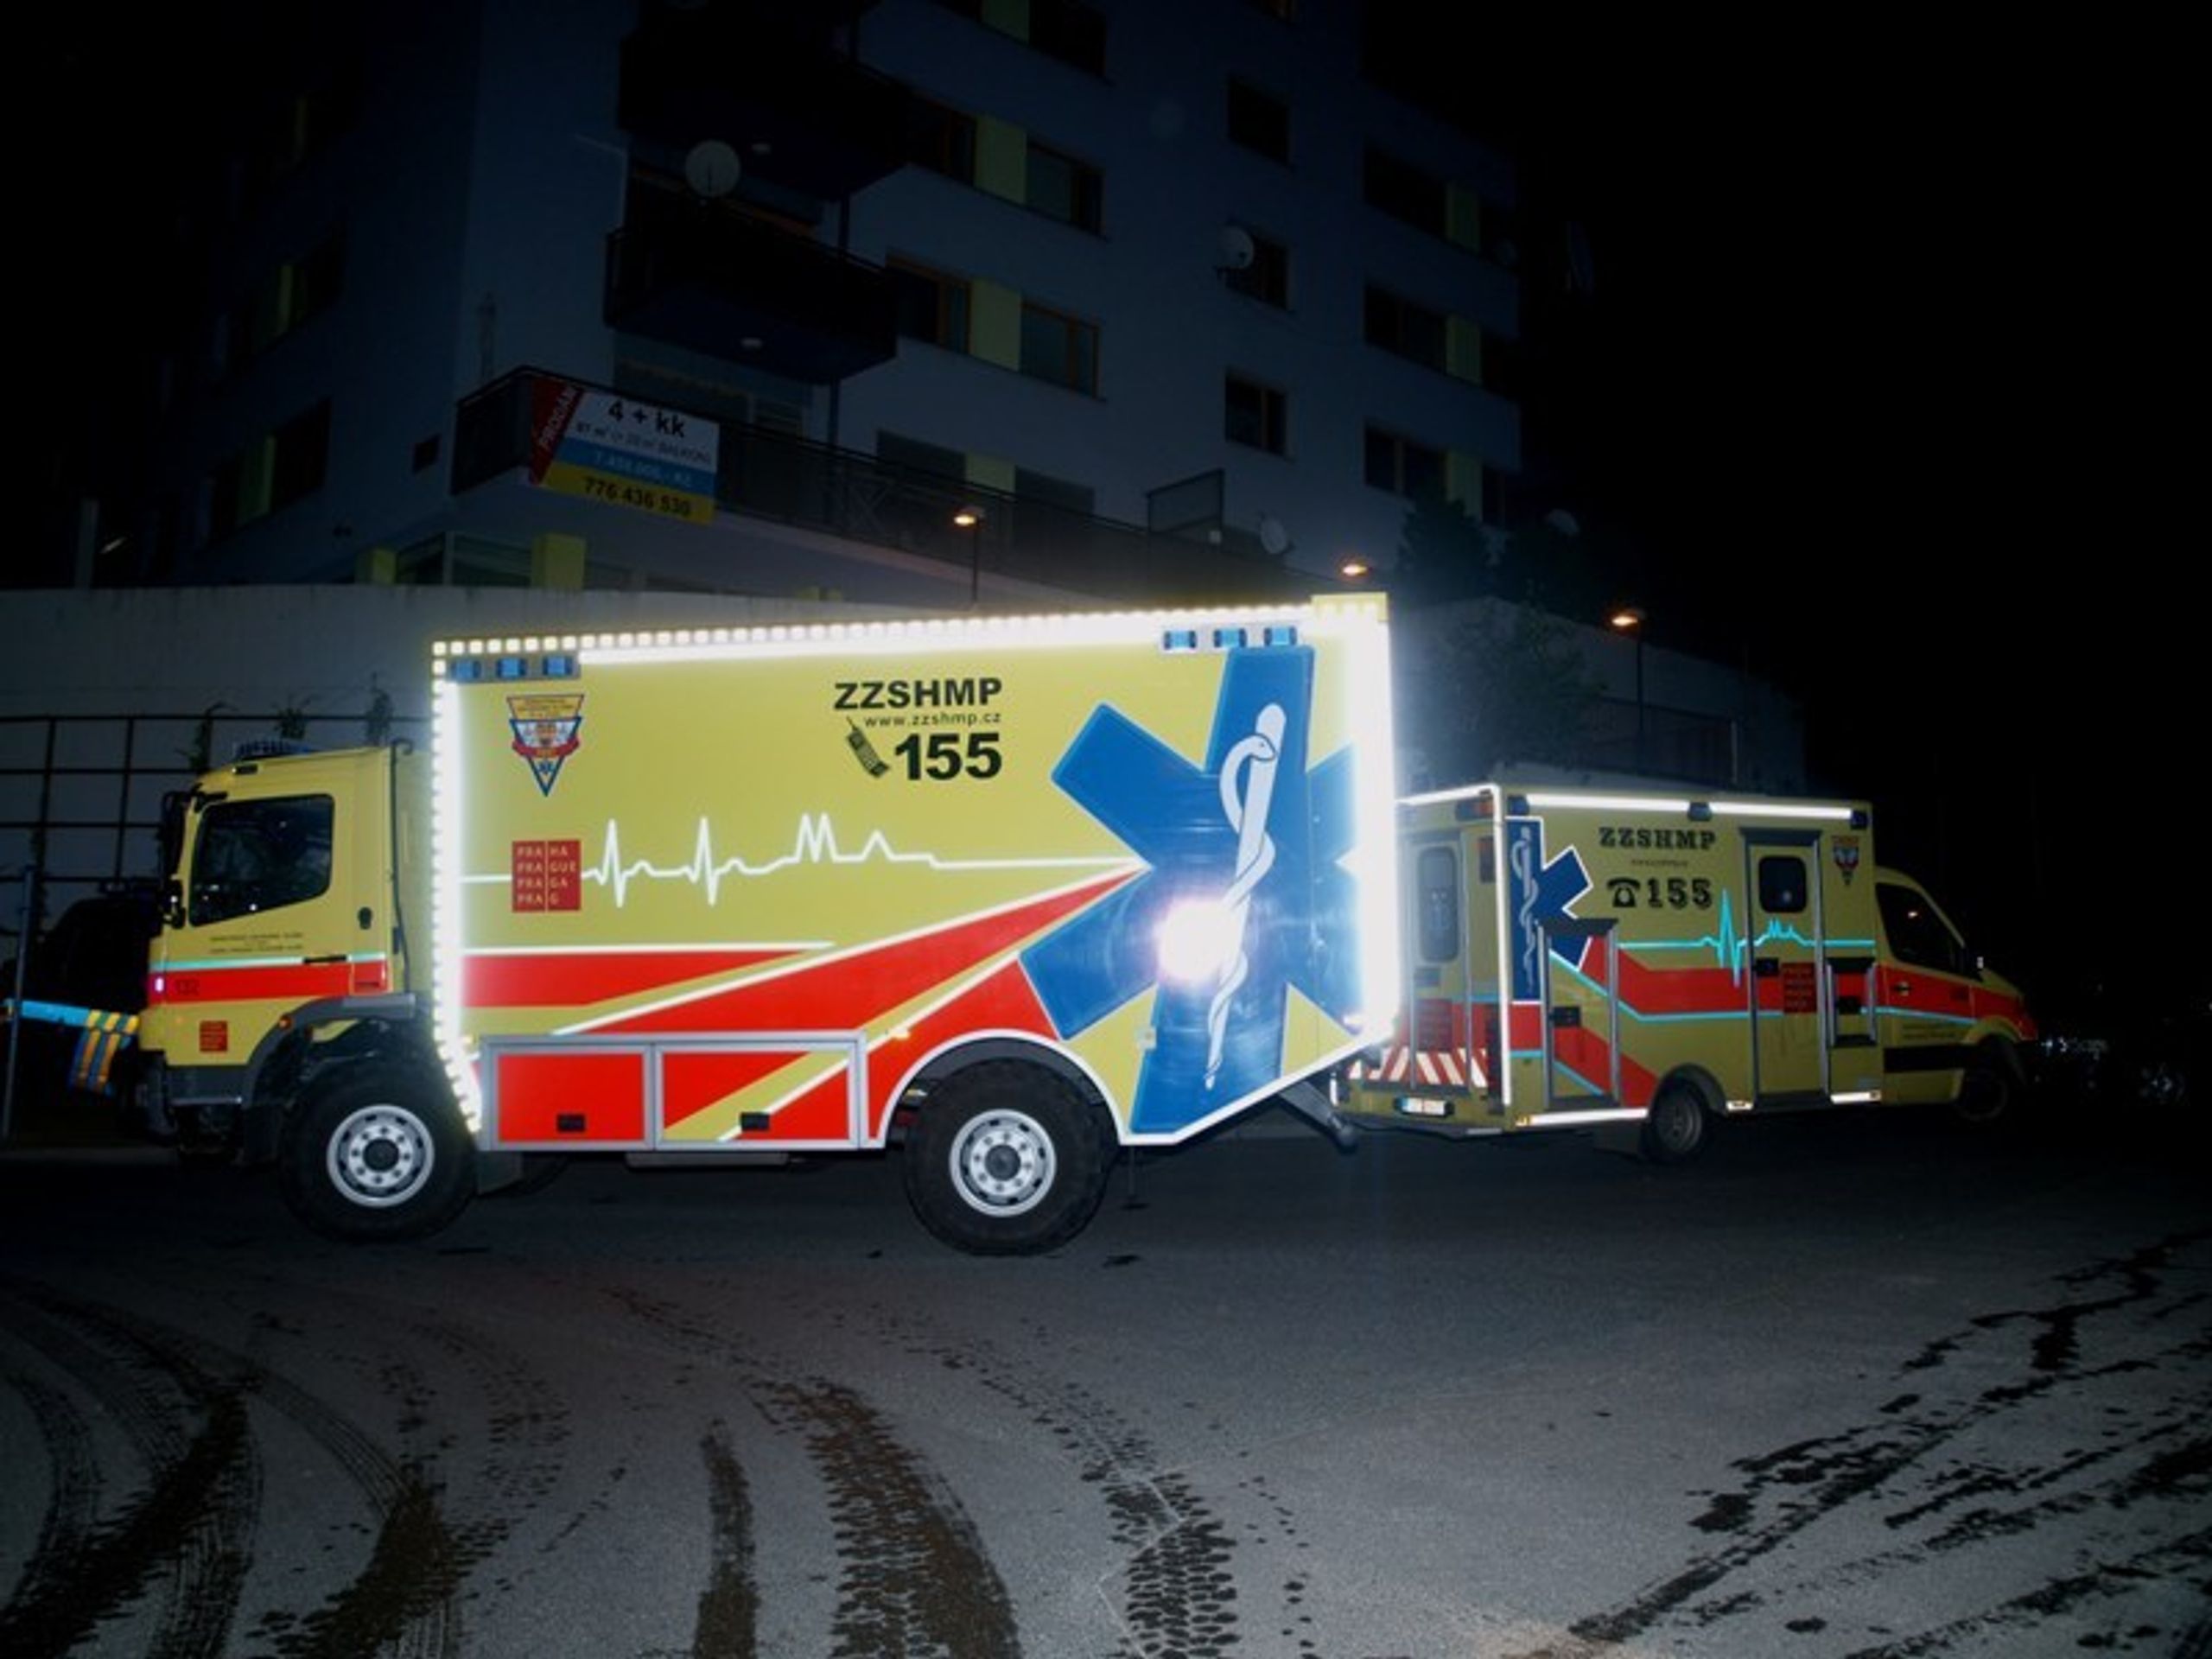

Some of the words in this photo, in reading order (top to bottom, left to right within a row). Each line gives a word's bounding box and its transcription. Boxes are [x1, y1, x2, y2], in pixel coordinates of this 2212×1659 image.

[608, 400, 624, 423] 4
[632, 408, 648, 424] +
[656, 412, 686, 438] kk
[582, 476, 619, 499] 776
[621, 484, 655, 508] 436
[834, 677, 1002, 709] ZZSHMP
[865, 711, 1001, 727] www.zzshmp.cz
[894, 732, 1002, 780] 155
[517, 846, 543, 857] PRA
[1599, 826, 1716, 849] ZZSHMP
[517, 877, 543, 889] PRA
[1647, 877, 1713, 909] 155
